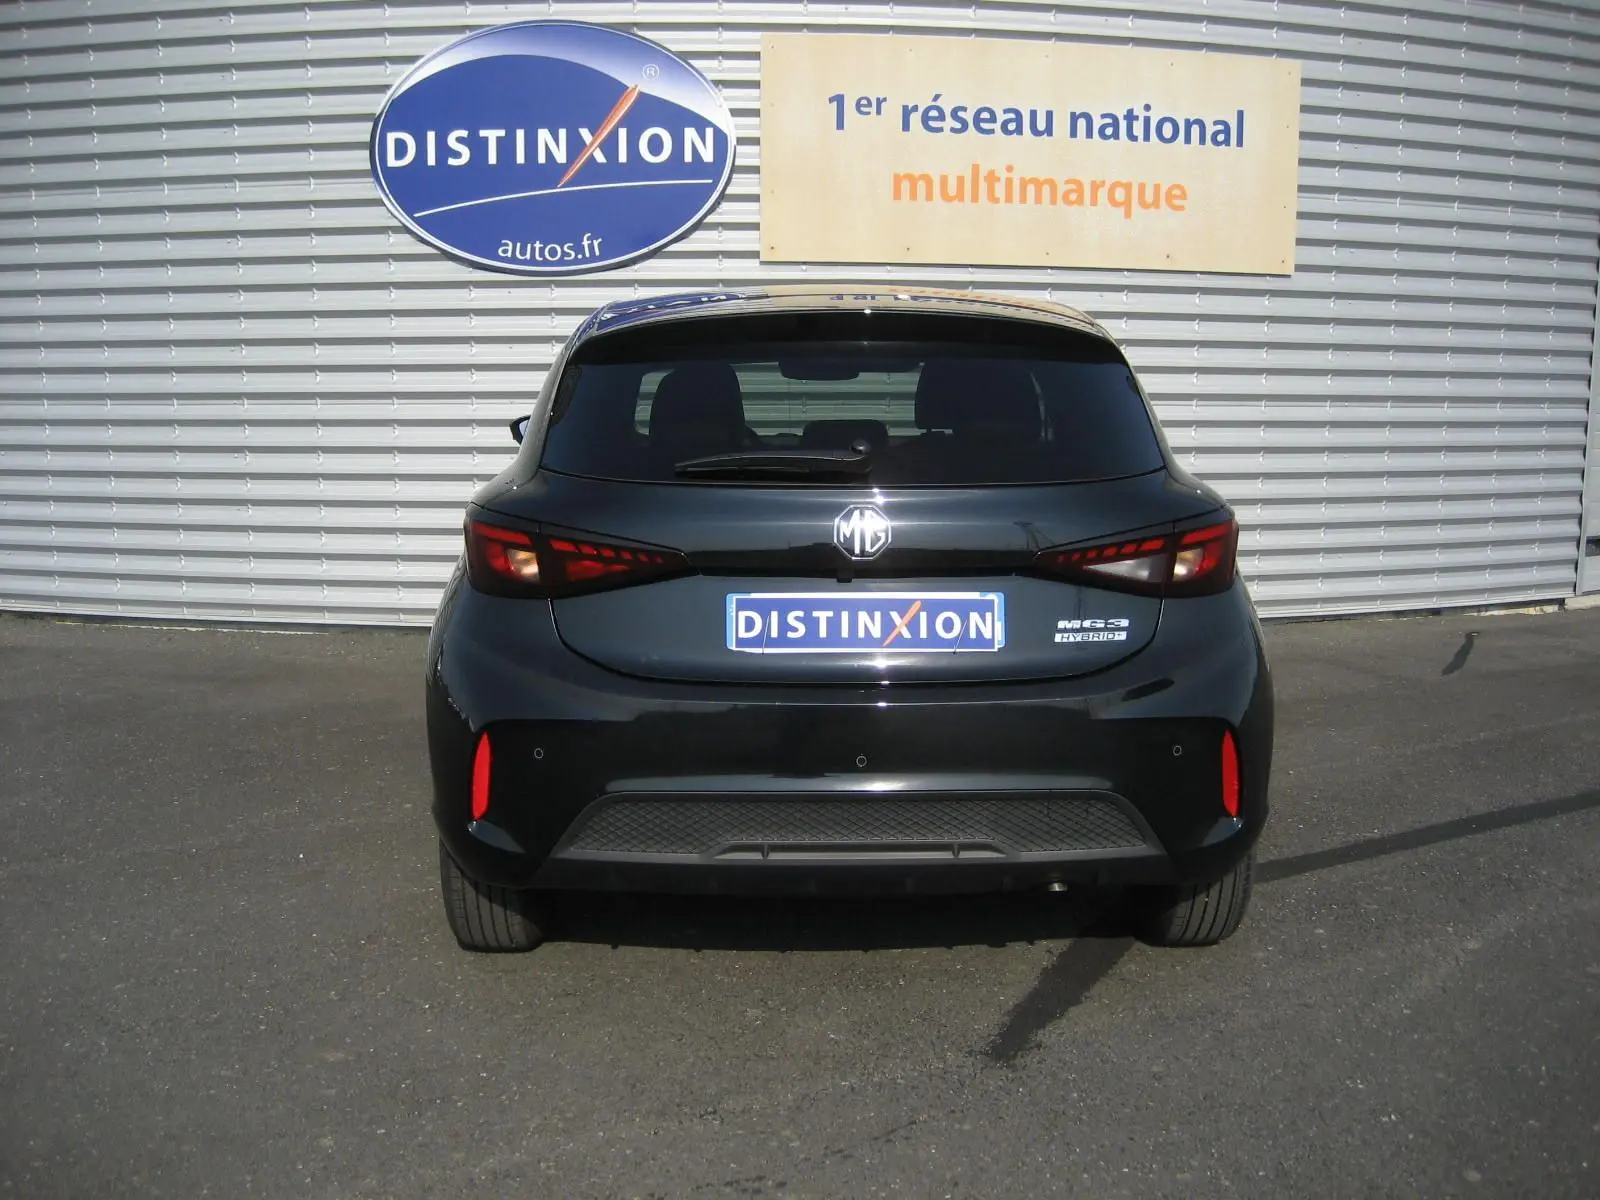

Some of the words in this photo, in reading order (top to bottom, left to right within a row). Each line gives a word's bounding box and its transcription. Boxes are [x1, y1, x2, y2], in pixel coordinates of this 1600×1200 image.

[828, 93, 887, 131] 1er
[901, 93, 1054, 138] réseau
[1069, 103, 1245, 148] national
[386, 127, 715, 168] DISTINXION
[892, 163, 1189, 219] multimarque
[497, 233, 604, 262] autos.fr
[839, 509, 886, 555] MG
[737, 609, 994, 641] DISTINXION
[1056, 618, 1130, 630] MG3
